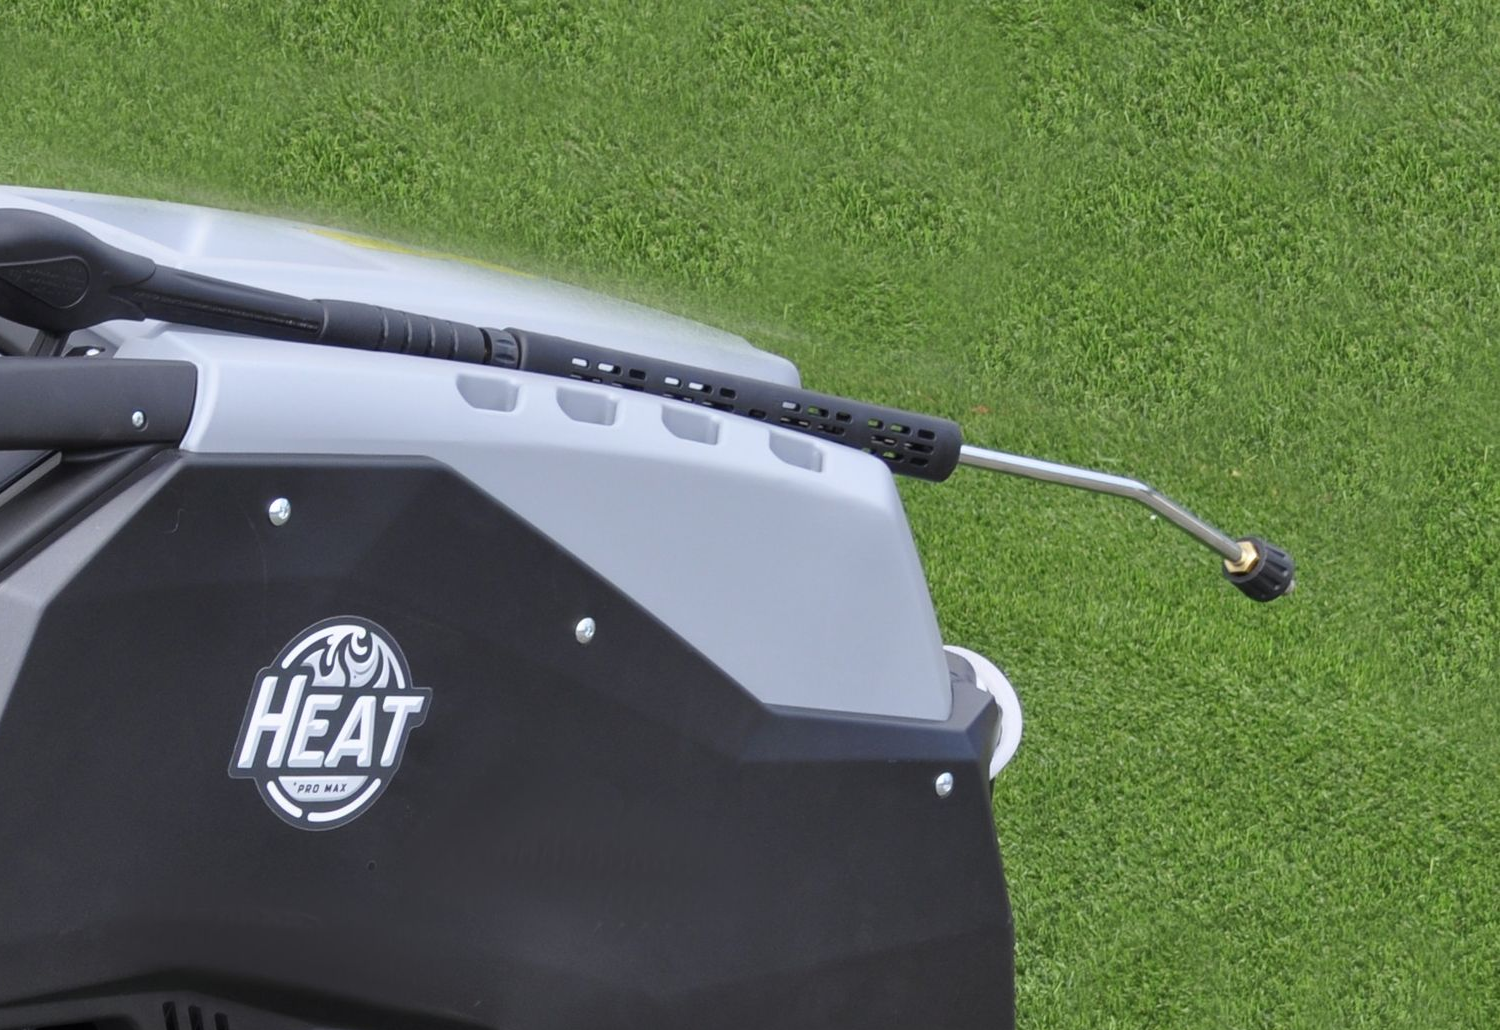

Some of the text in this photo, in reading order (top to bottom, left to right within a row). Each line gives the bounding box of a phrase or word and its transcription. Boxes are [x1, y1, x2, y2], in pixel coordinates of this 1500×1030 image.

[237, 675, 425, 768] HEAT
[297, 783, 347, 794] PRO MAX
